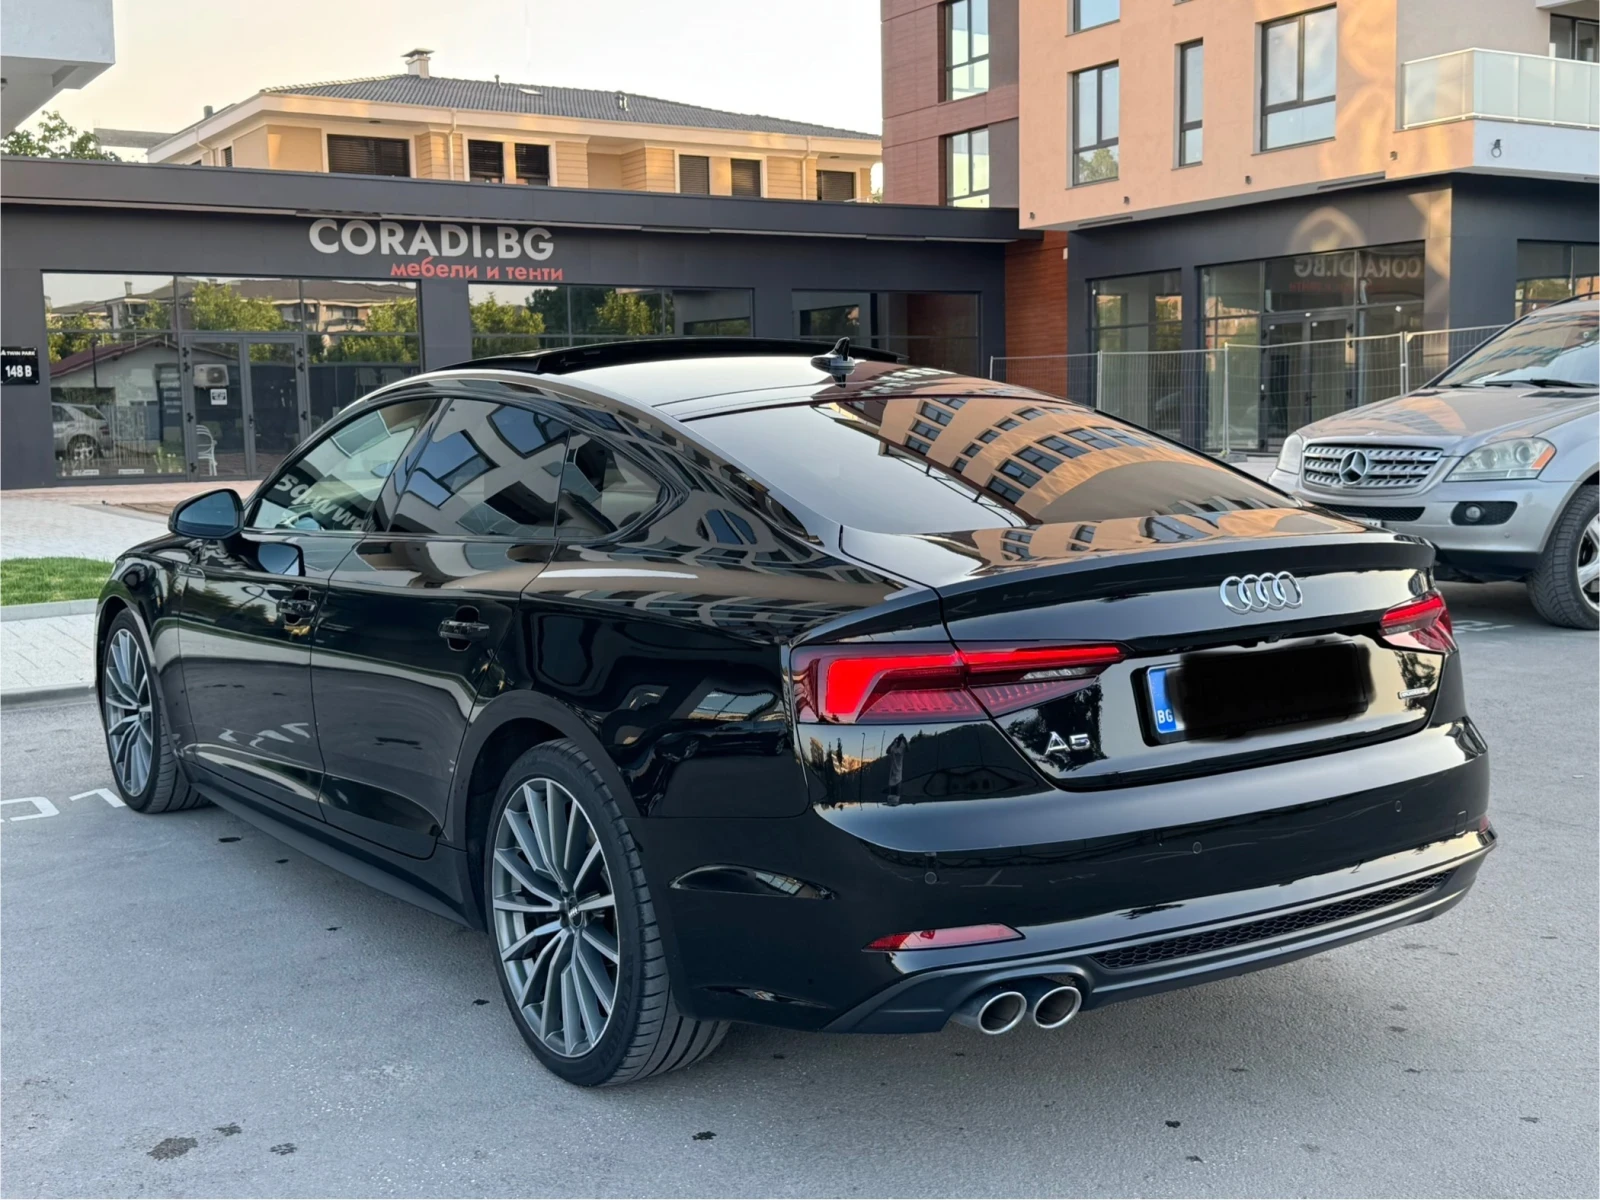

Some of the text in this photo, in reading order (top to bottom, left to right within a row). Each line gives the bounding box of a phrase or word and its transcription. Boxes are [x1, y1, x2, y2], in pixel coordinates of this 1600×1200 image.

[308, 218, 555, 261] CORADI.BG
[390, 256, 564, 281] мебели и тенти
[5, 365, 32, 377] 148 B
[1156, 708, 1175, 725] BG
[1044, 730, 1092, 756] A5
